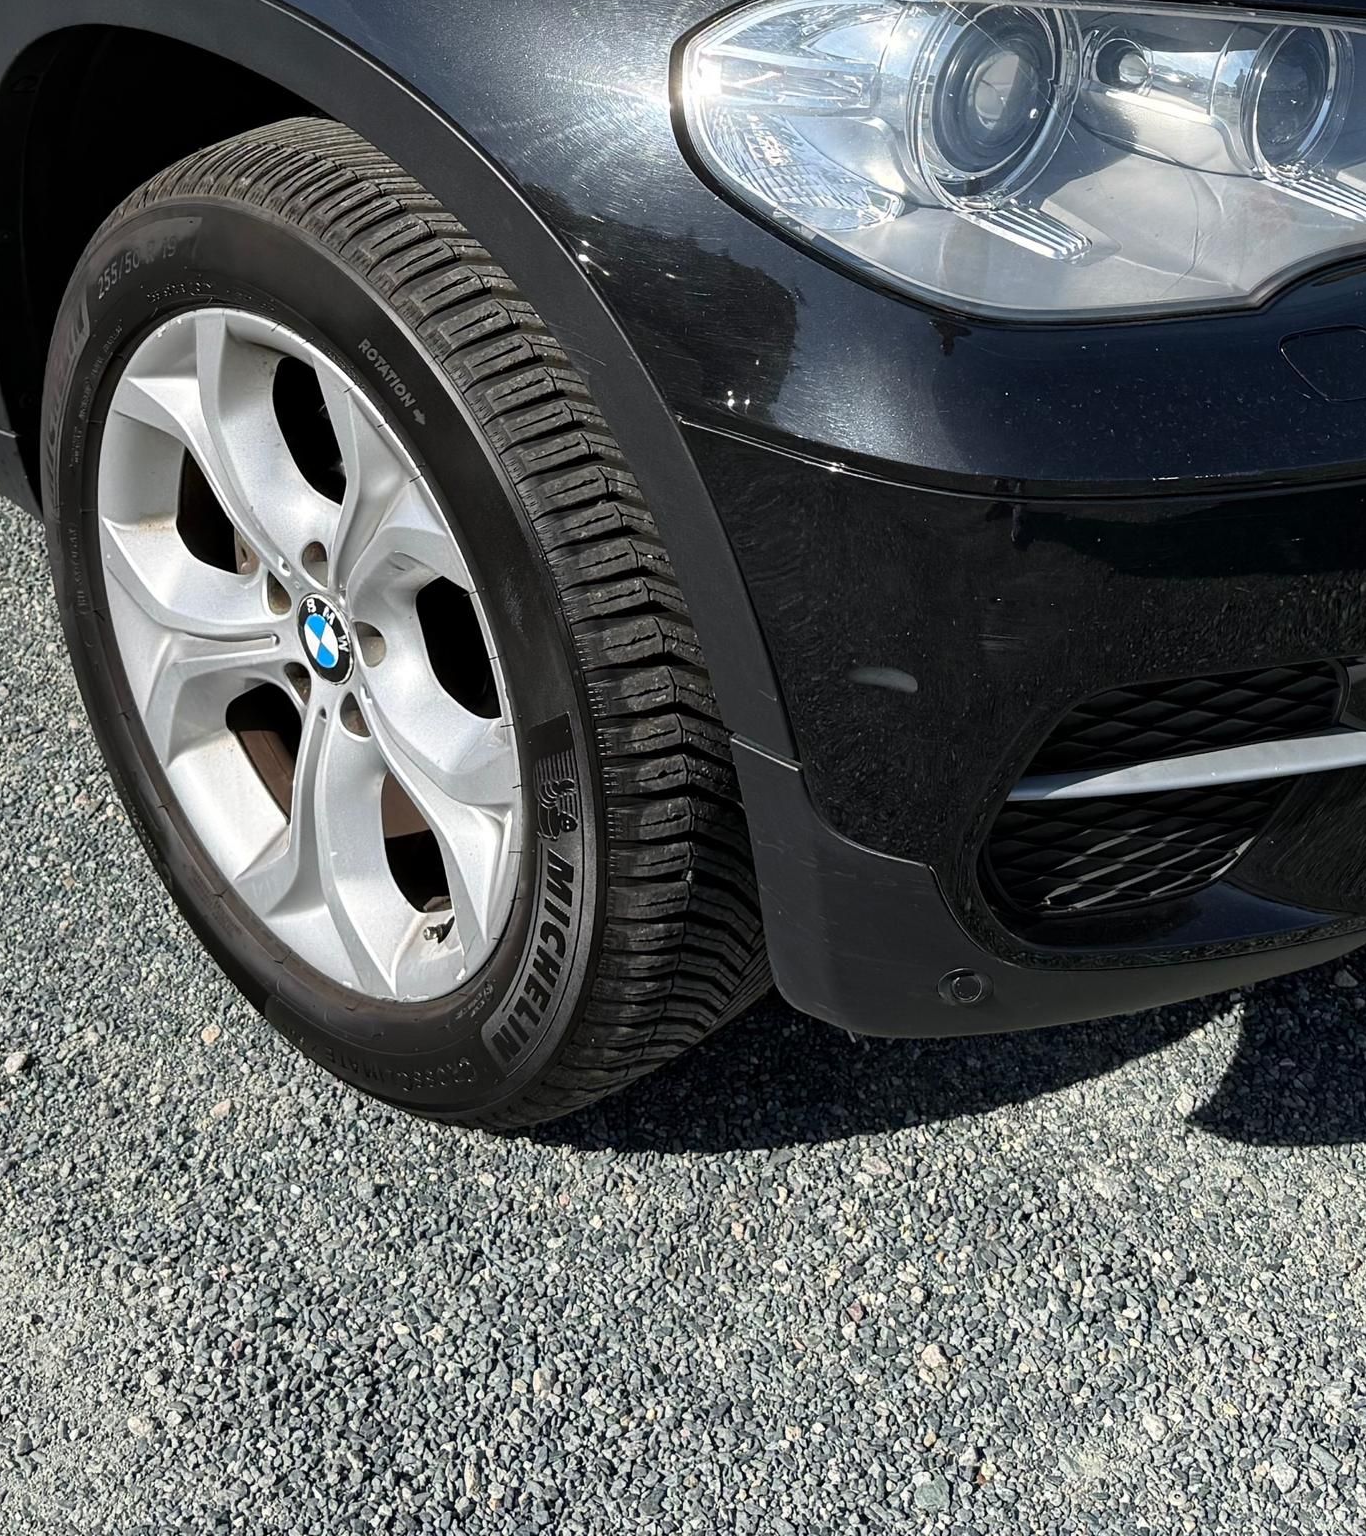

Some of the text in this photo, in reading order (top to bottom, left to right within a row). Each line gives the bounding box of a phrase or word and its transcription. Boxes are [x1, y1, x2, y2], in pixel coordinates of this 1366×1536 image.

[357, 338, 417, 408] ROTATION
[306, 597, 350, 653] BMW
[490, 848, 575, 1064] MICHELIN
